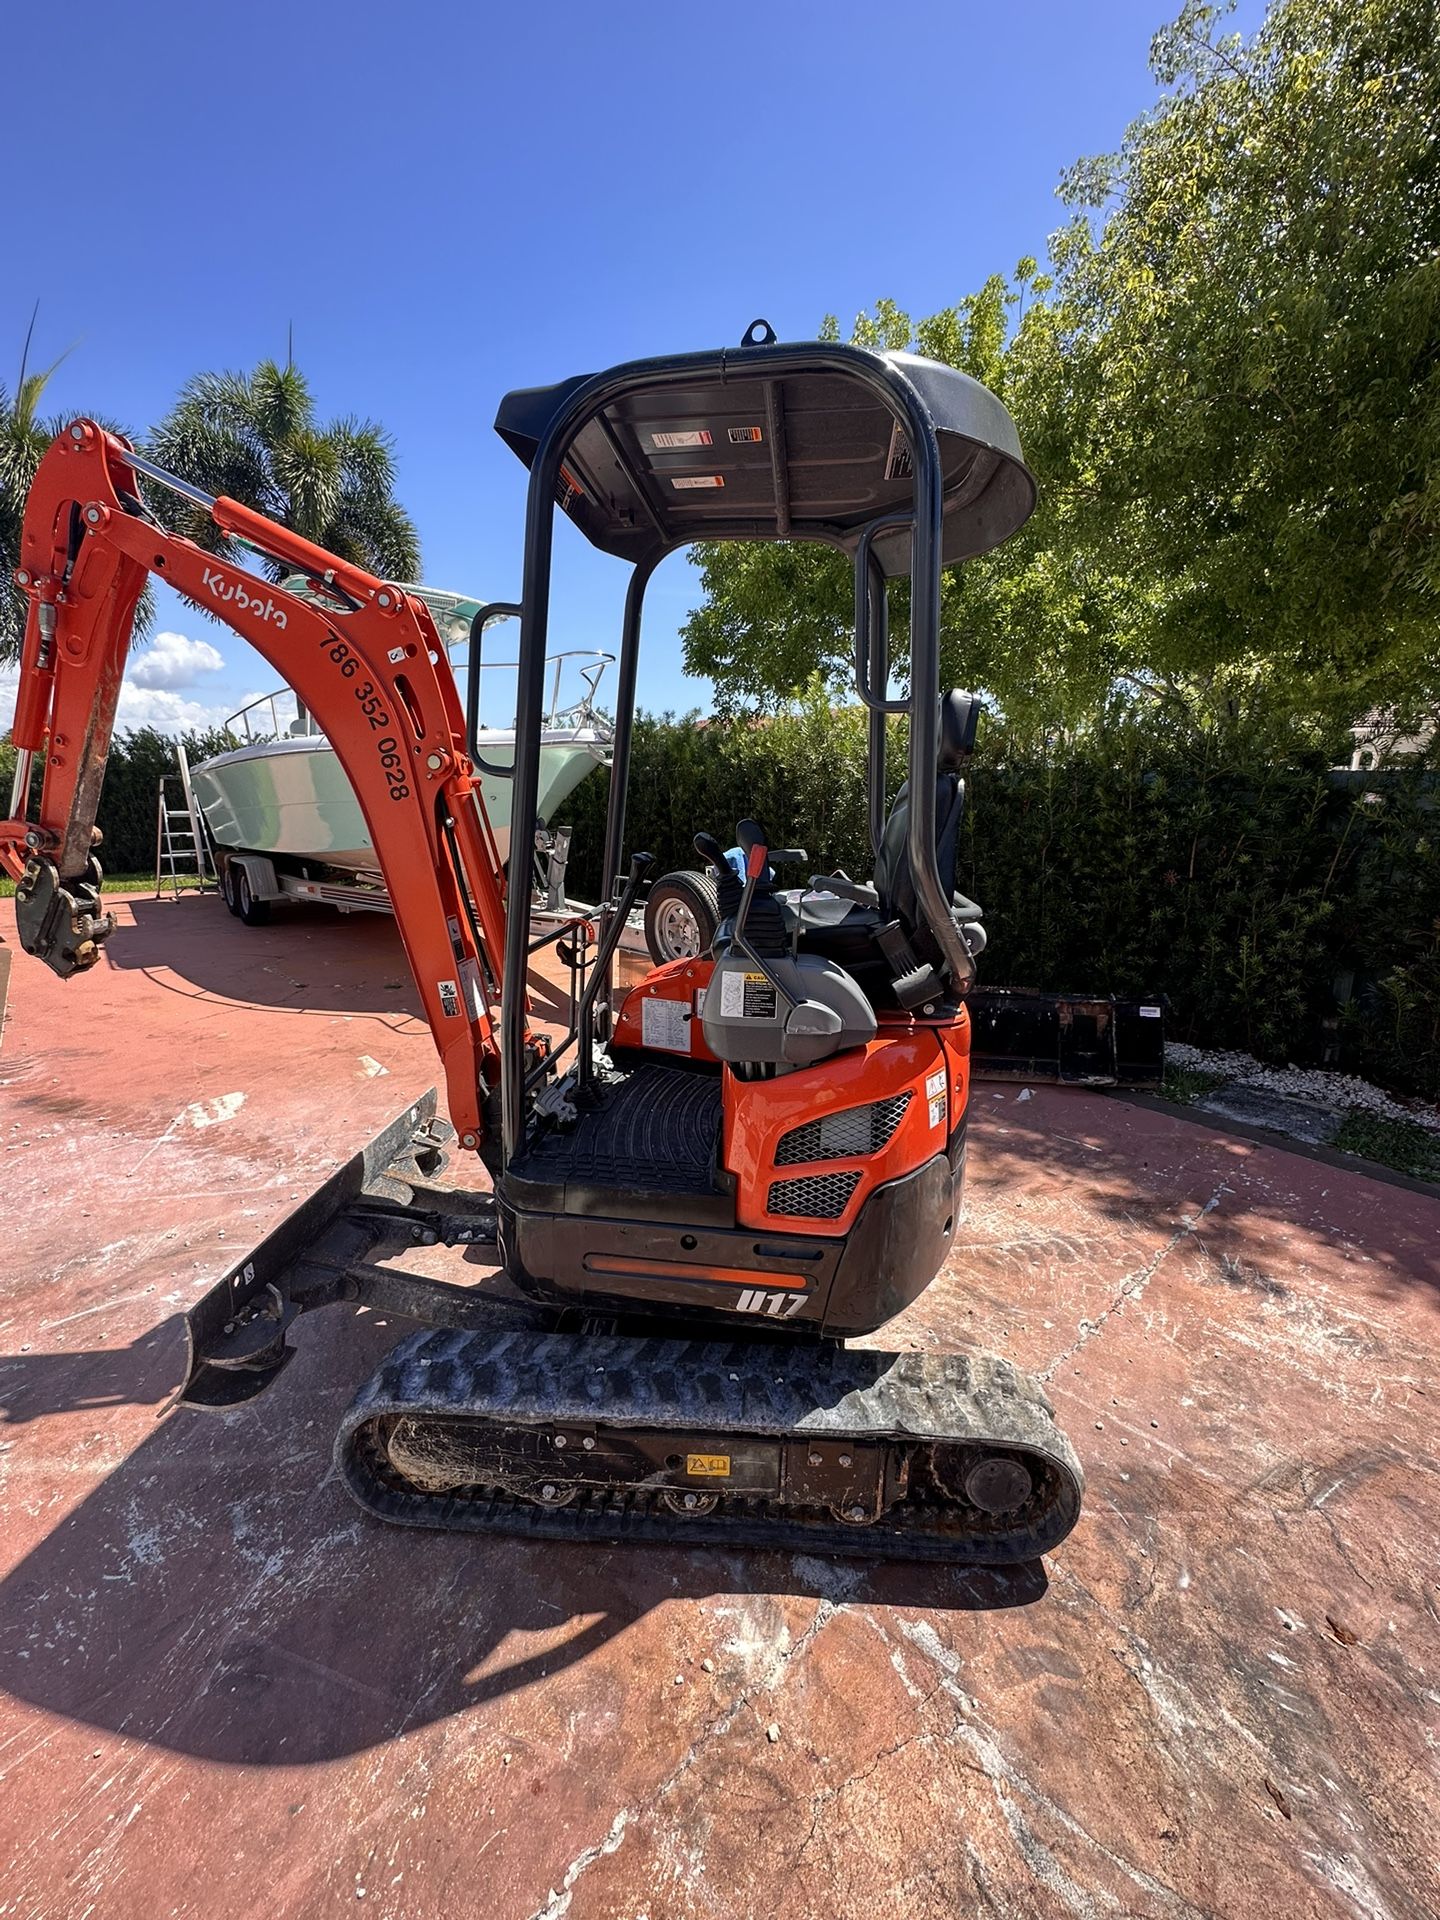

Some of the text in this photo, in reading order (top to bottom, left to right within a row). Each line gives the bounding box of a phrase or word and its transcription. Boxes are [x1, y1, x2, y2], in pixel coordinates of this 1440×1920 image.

[203, 568, 288, 630] Kubota
[319, 629, 410, 801] 786 352 0628
[736, 1290, 808, 1316] U17
